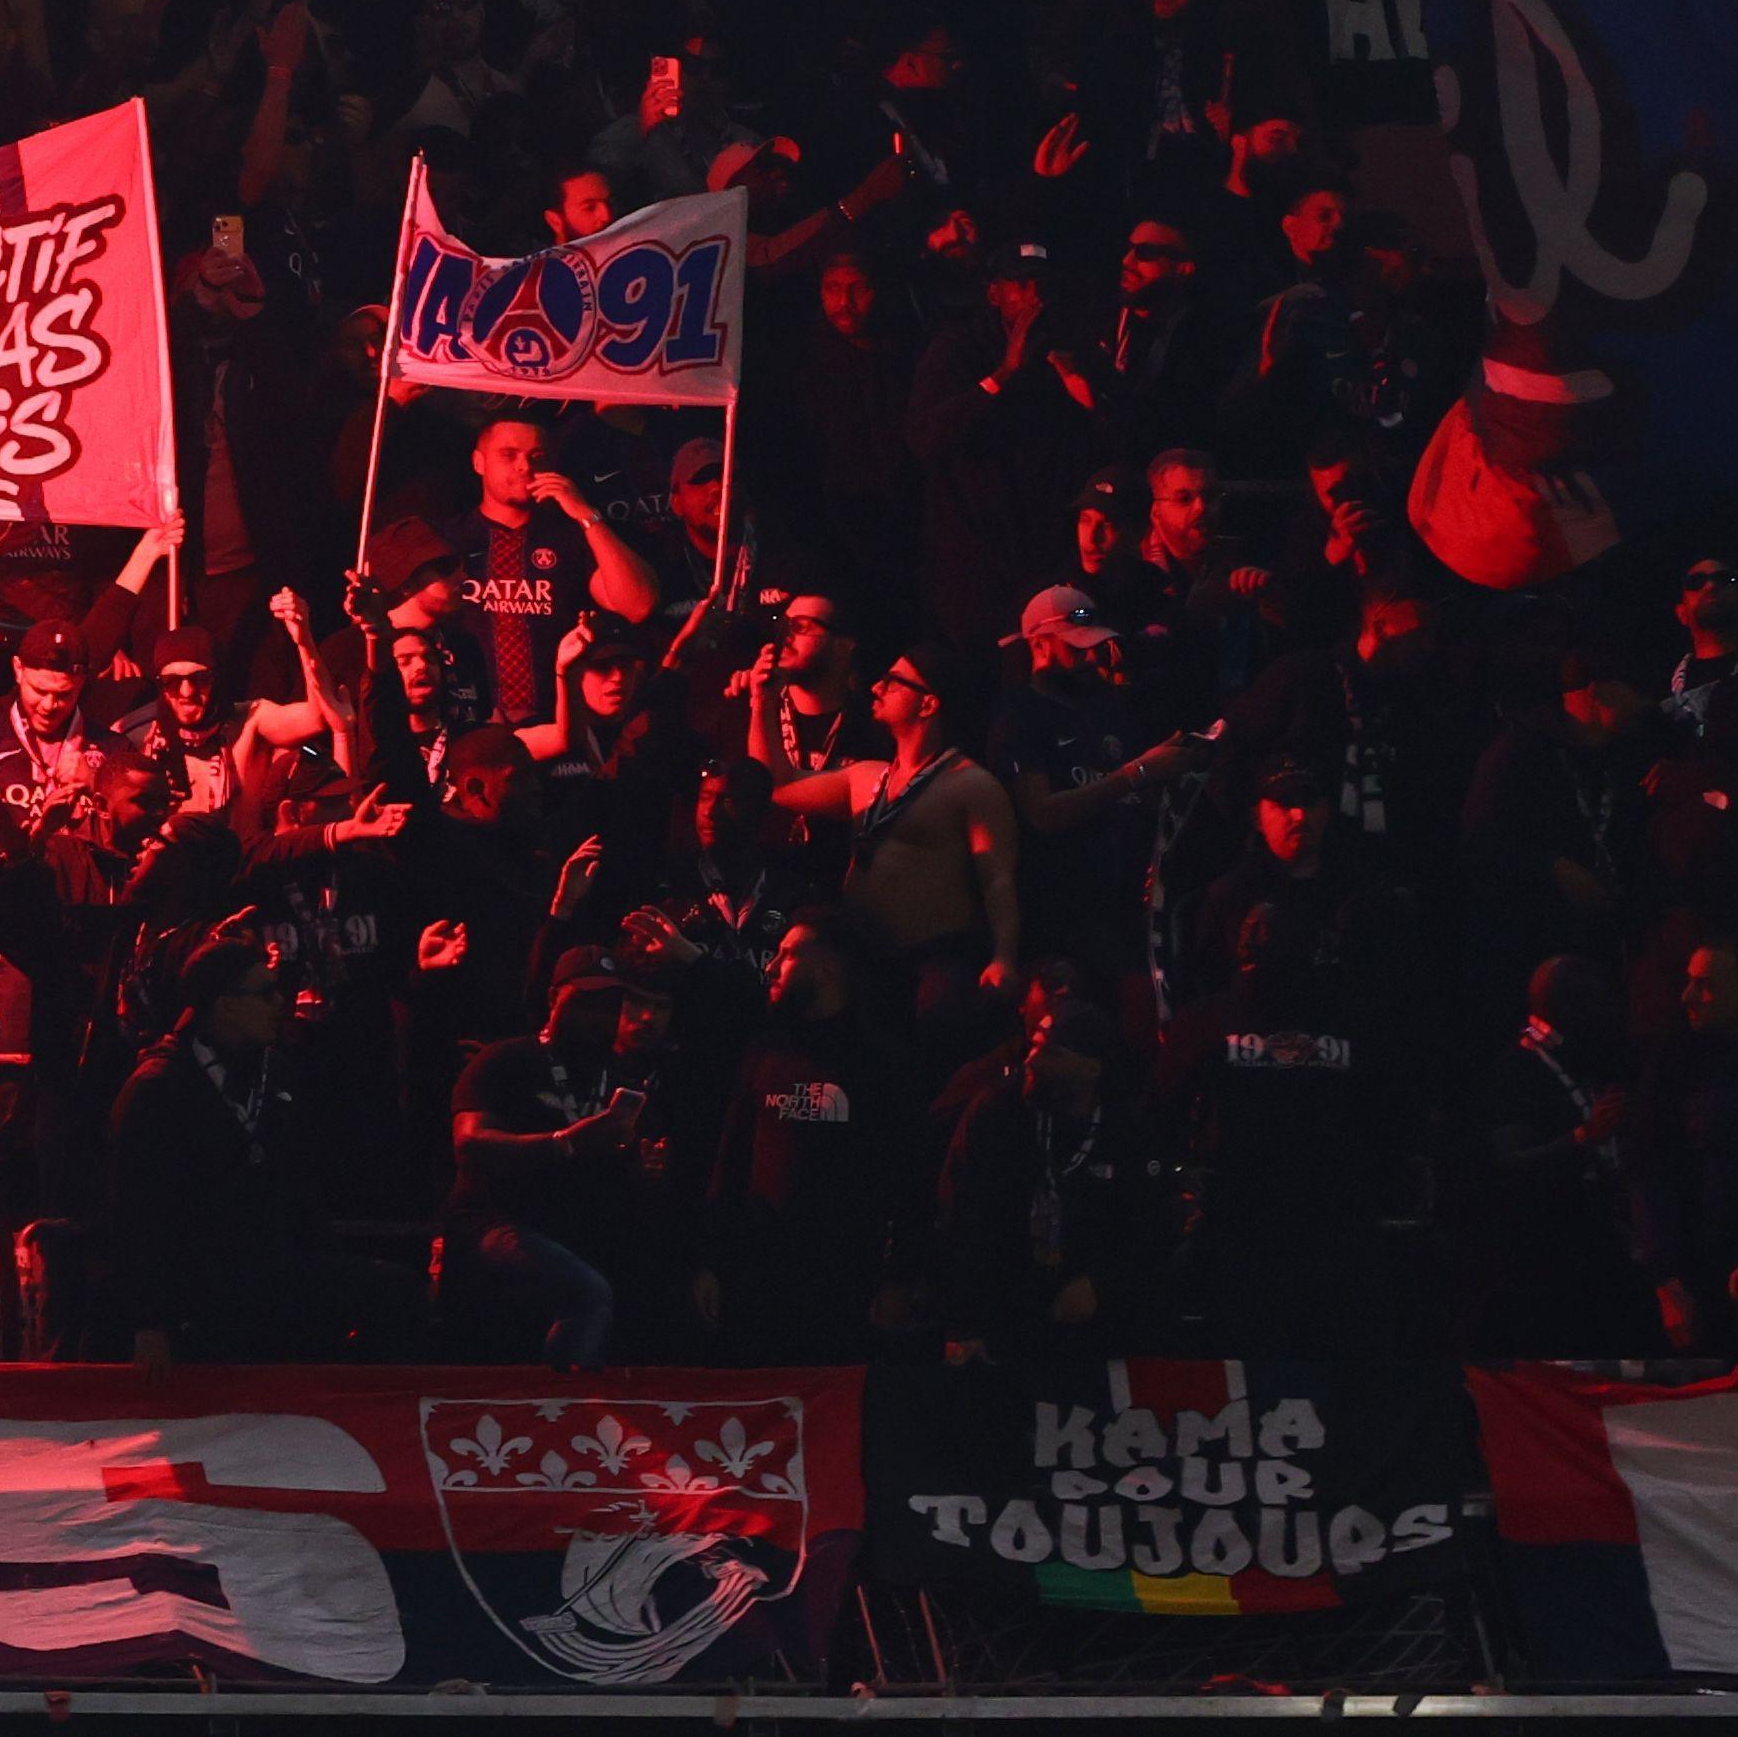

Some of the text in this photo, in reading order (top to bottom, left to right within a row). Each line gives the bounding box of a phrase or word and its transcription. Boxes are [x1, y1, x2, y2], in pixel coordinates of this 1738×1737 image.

[595, 242, 726, 370] 91
[461, 578, 552, 604] QATAR
[483, 600, 553, 616] AIRWAYS
[1224, 1032, 1351, 1066] 19 91
[764, 1093, 822, 1109] NORTH
[793, 1082, 823, 1096] THE
[778, 1106, 820, 1122] FACE
[1034, 1398, 1326, 1469] KAMA
[1050, 1455, 1315, 1506] POUR
[908, 1494, 1454, 1577] TOUJOURS
